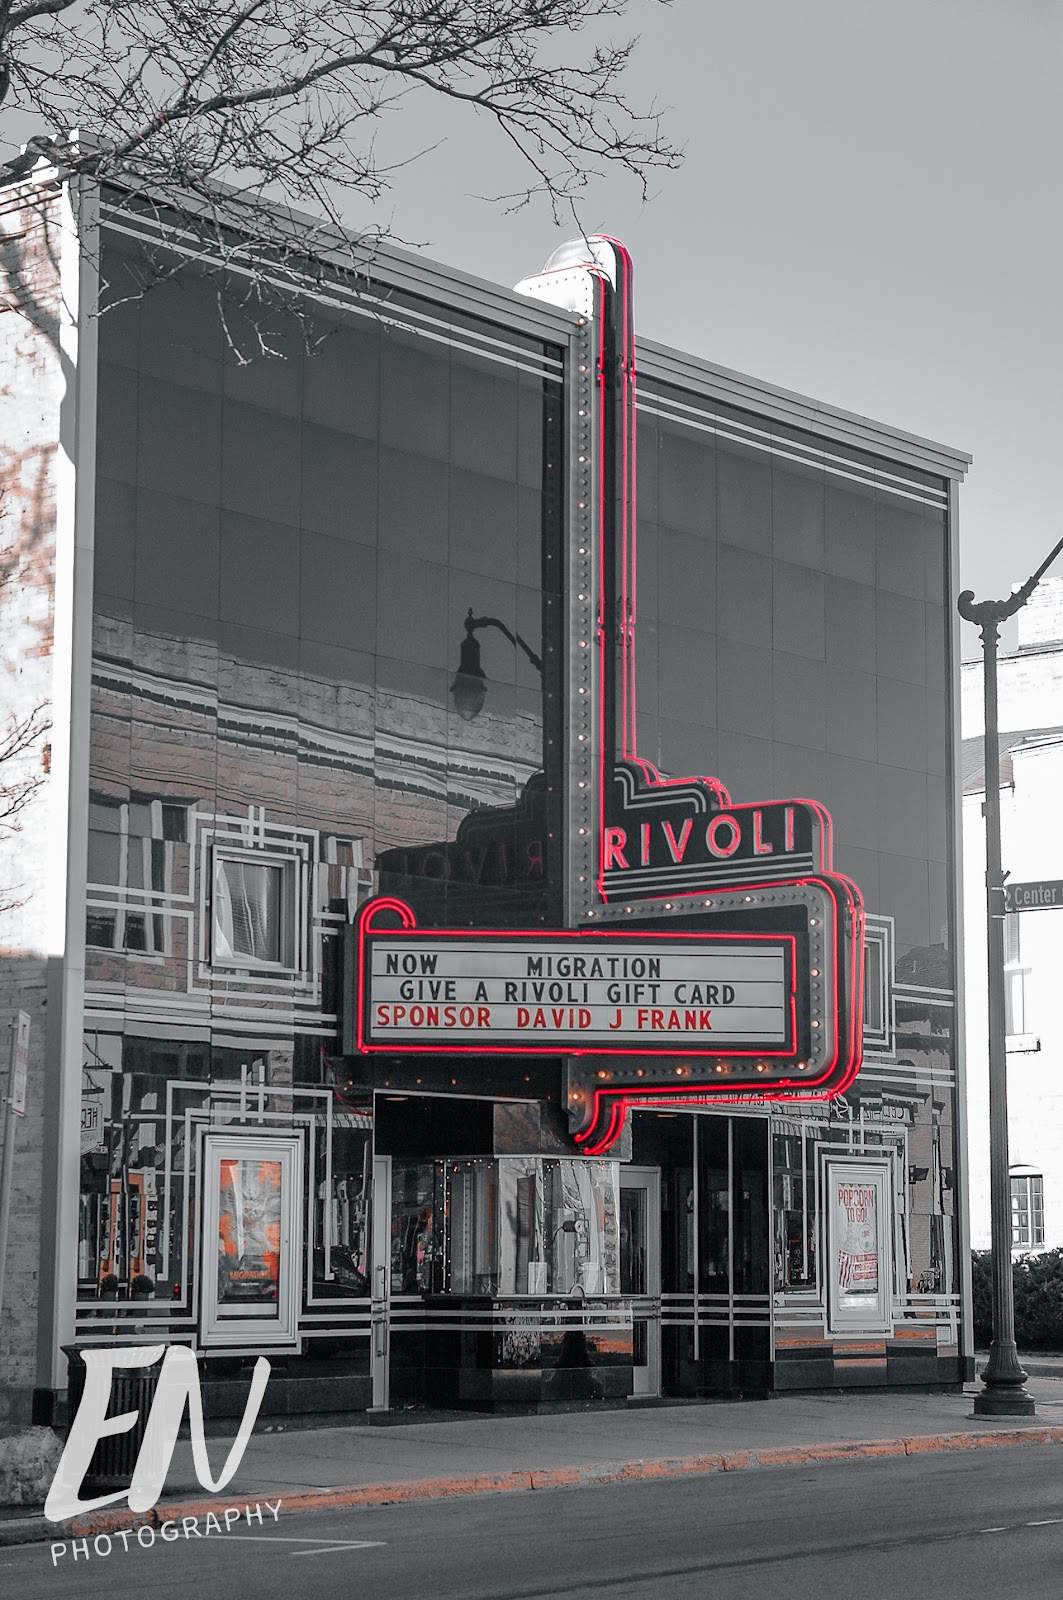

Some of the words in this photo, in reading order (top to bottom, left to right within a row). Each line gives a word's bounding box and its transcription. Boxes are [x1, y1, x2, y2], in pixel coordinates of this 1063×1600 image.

[604, 807, 794, 870] RIVOLI
[1015, 886, 1056, 905] Center
[386, 954, 438, 975] NOW
[527, 956, 661, 978] MIGRATION
[400, 980, 456, 1001] GIVE
[475, 981, 489, 1002] A
[505, 982, 588, 1003] RIVOLI
[607, 983, 660, 1004] GIFT
[674, 984, 735, 1005] CARD
[377, 1005, 491, 1027] SPONSOR
[517, 1007, 592, 1029] DAVID
[609, 1008, 622, 1029] J
[638, 1009, 712, 1030] FRANK
[838, 1189, 874, 1207] POPCORN
[846, 1207, 855, 1222] TO
